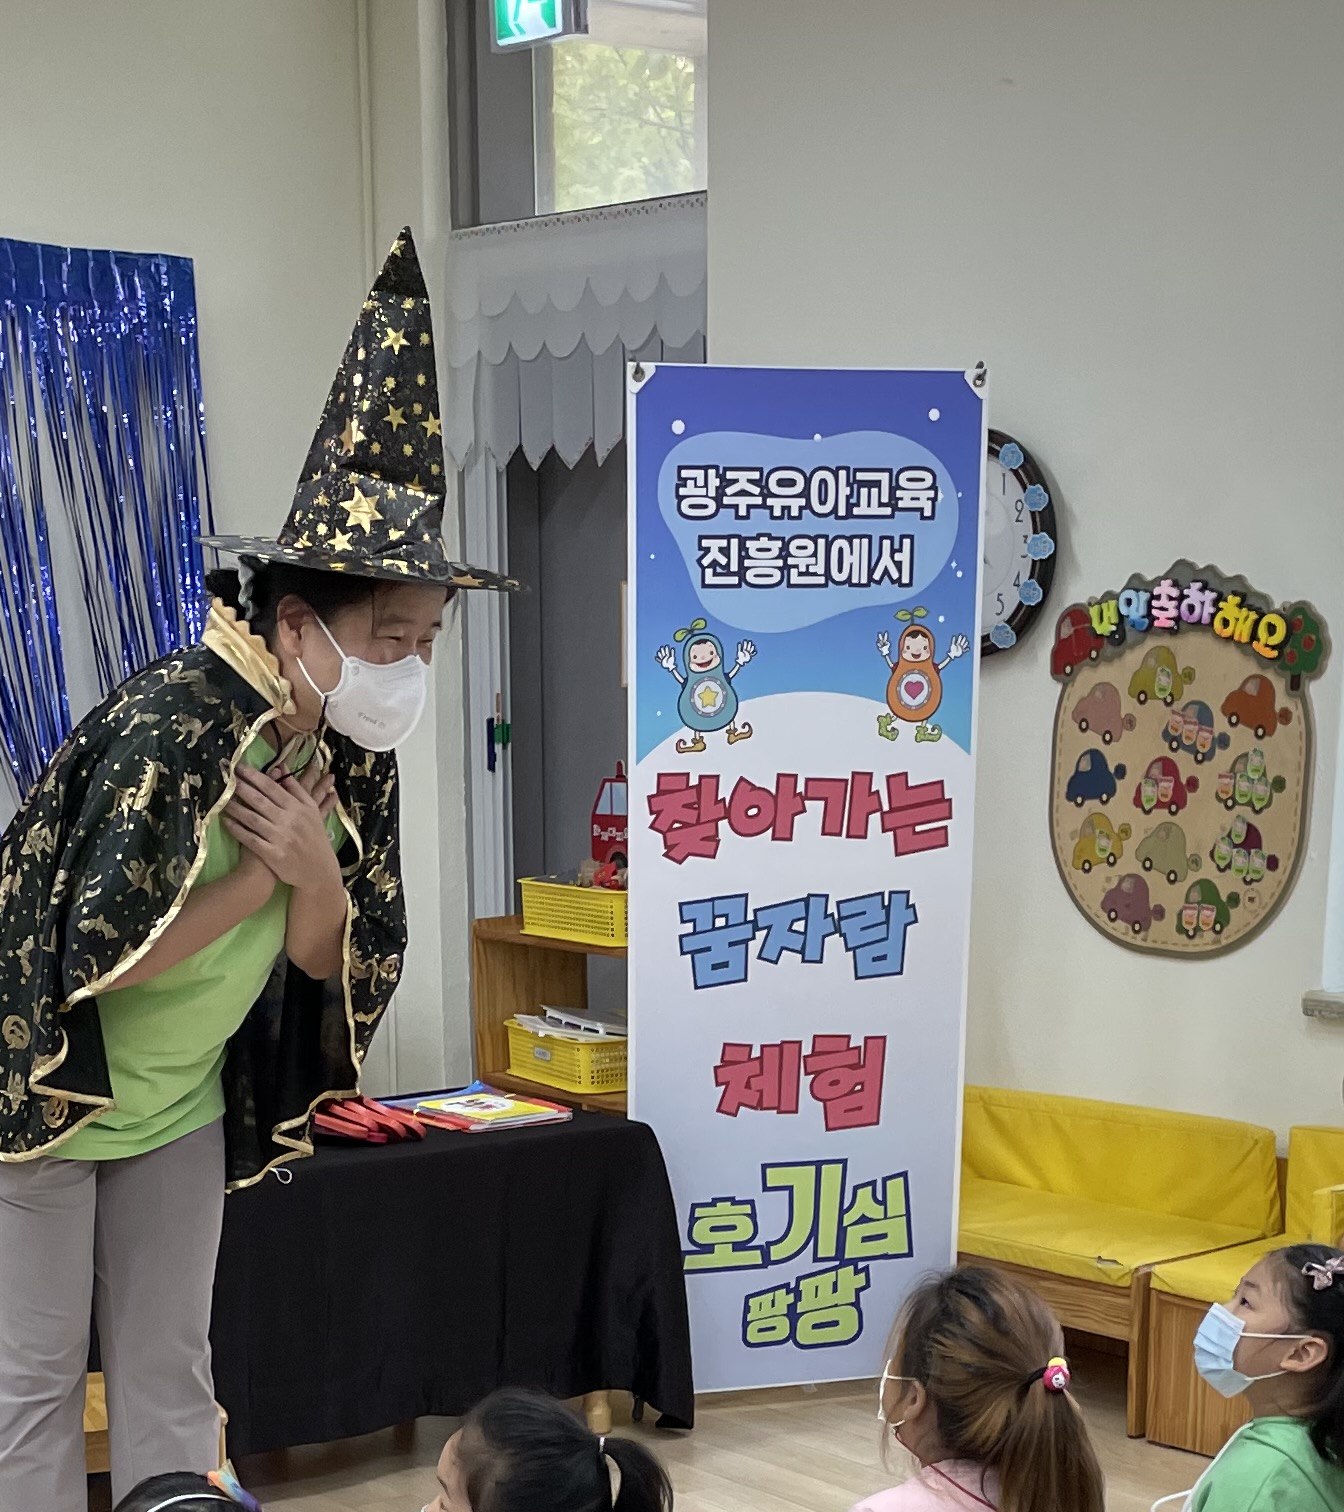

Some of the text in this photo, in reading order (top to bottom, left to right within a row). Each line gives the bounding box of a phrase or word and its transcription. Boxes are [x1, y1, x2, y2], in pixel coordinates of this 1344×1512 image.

[675, 465, 939, 520] 광주유아교육
[698, 533, 914, 588] 진흥원에서
[647, 770, 953, 865] 찾아가는
[678, 890, 919, 990] 꿈자람
[713, 1034, 888, 1132] 체험
[681, 1158, 914, 1274] 호기심
[741, 1261, 871, 1350] 팡팡
